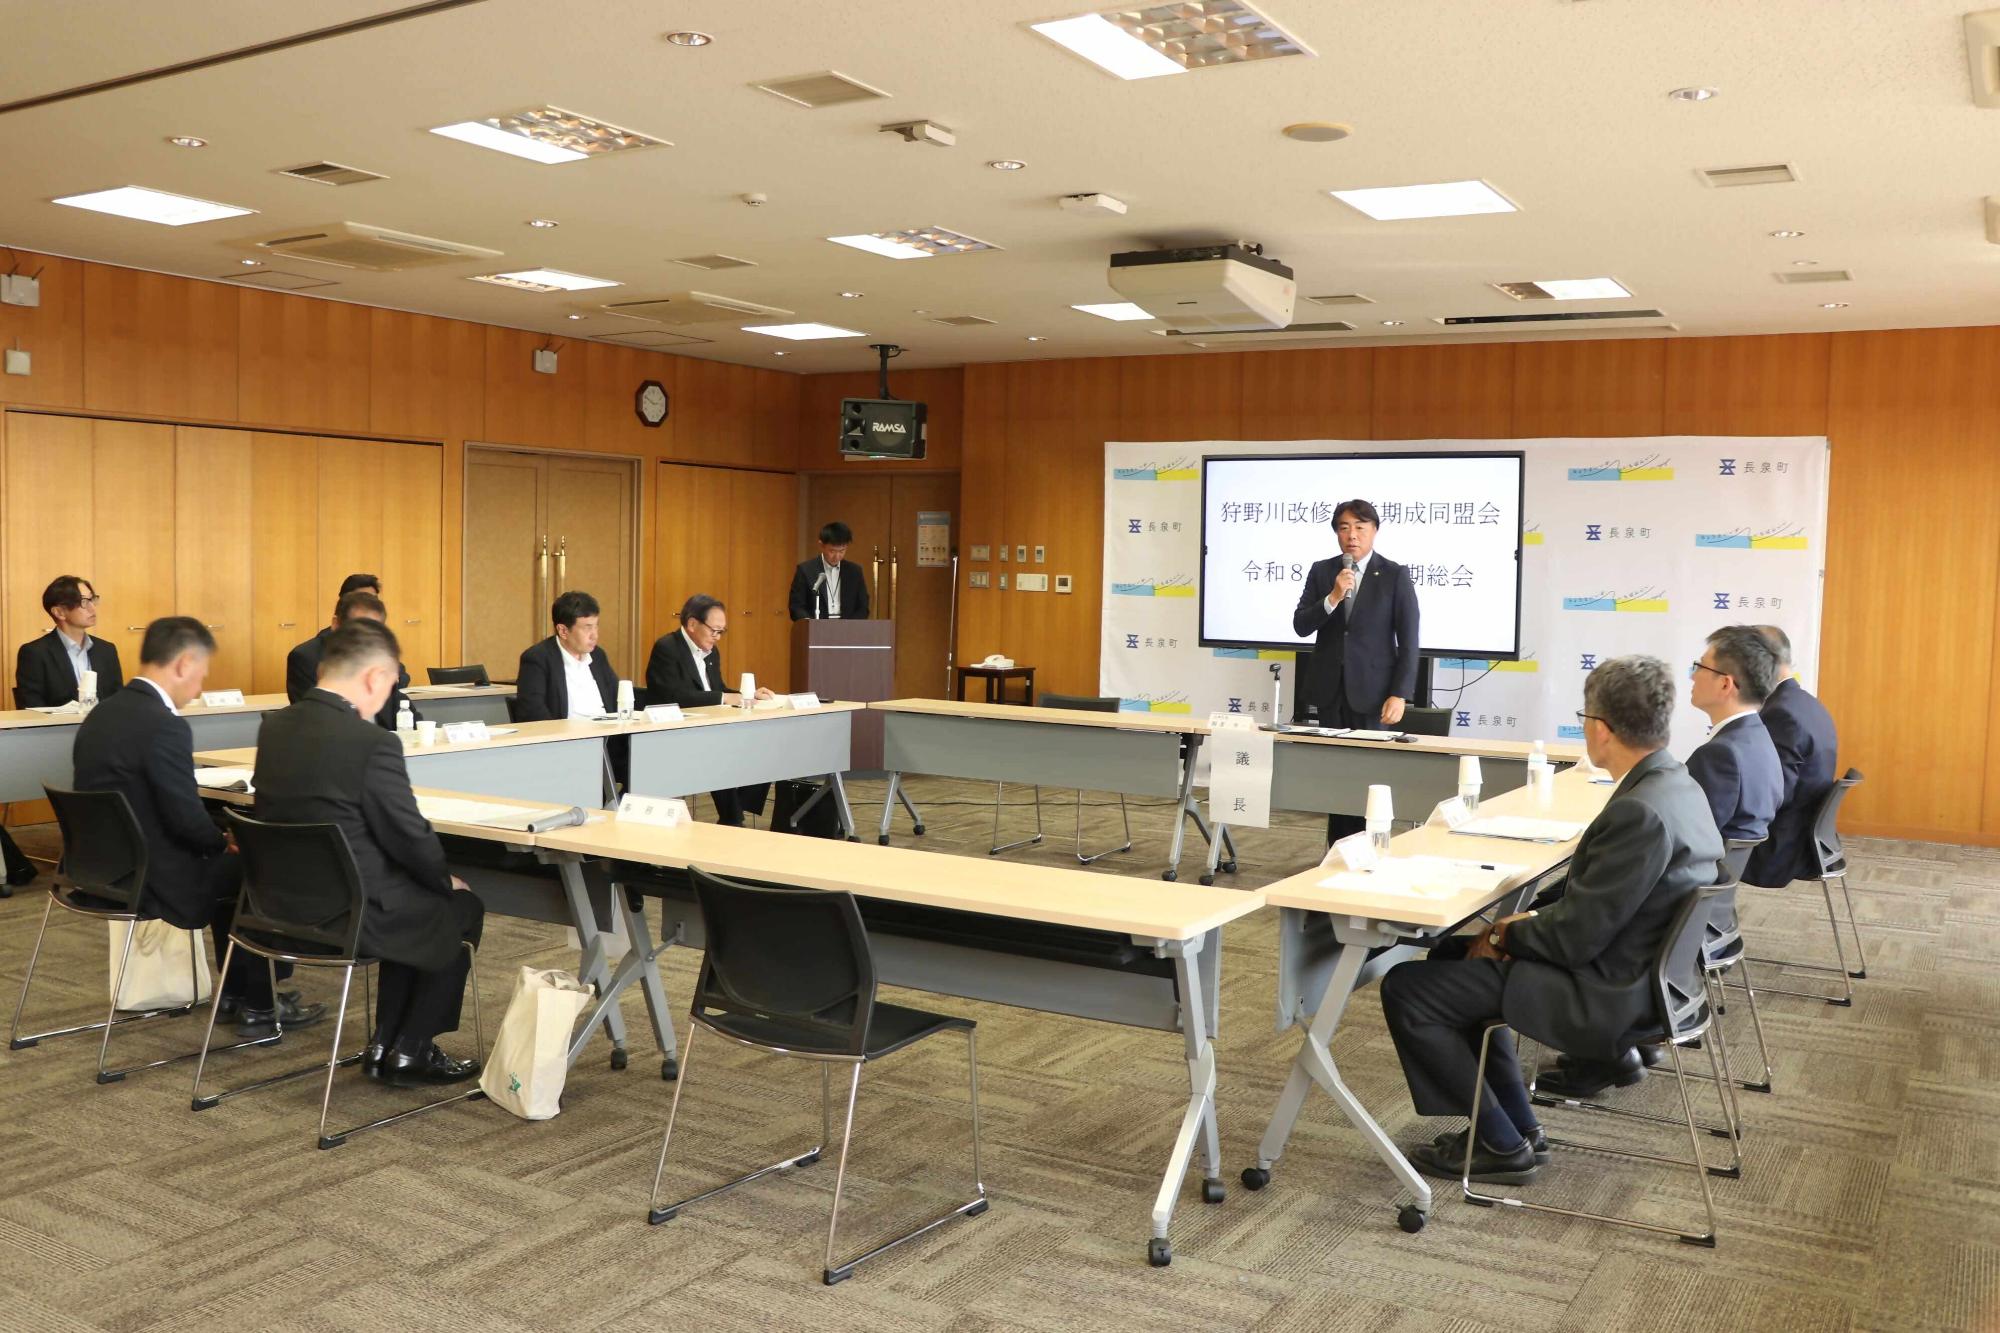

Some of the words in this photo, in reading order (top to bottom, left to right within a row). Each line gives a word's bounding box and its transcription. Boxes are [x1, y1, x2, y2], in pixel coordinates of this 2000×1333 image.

[872, 421, 907, 433] RAMSA
[1743, 460, 1788, 474] 長泉町
[1221, 501, 1500, 525] 狩野川改修期成同盟会
[1148, 521, 1182, 533] 長泉町
[1609, 526, 1652, 539] 長泉町
[1738, 596, 1783, 610] 長泉町
[1145, 638, 1178, 649] 長泉町
[1478, 714, 1518, 728] 長泉町
[1233, 751, 1250, 812] 議長
